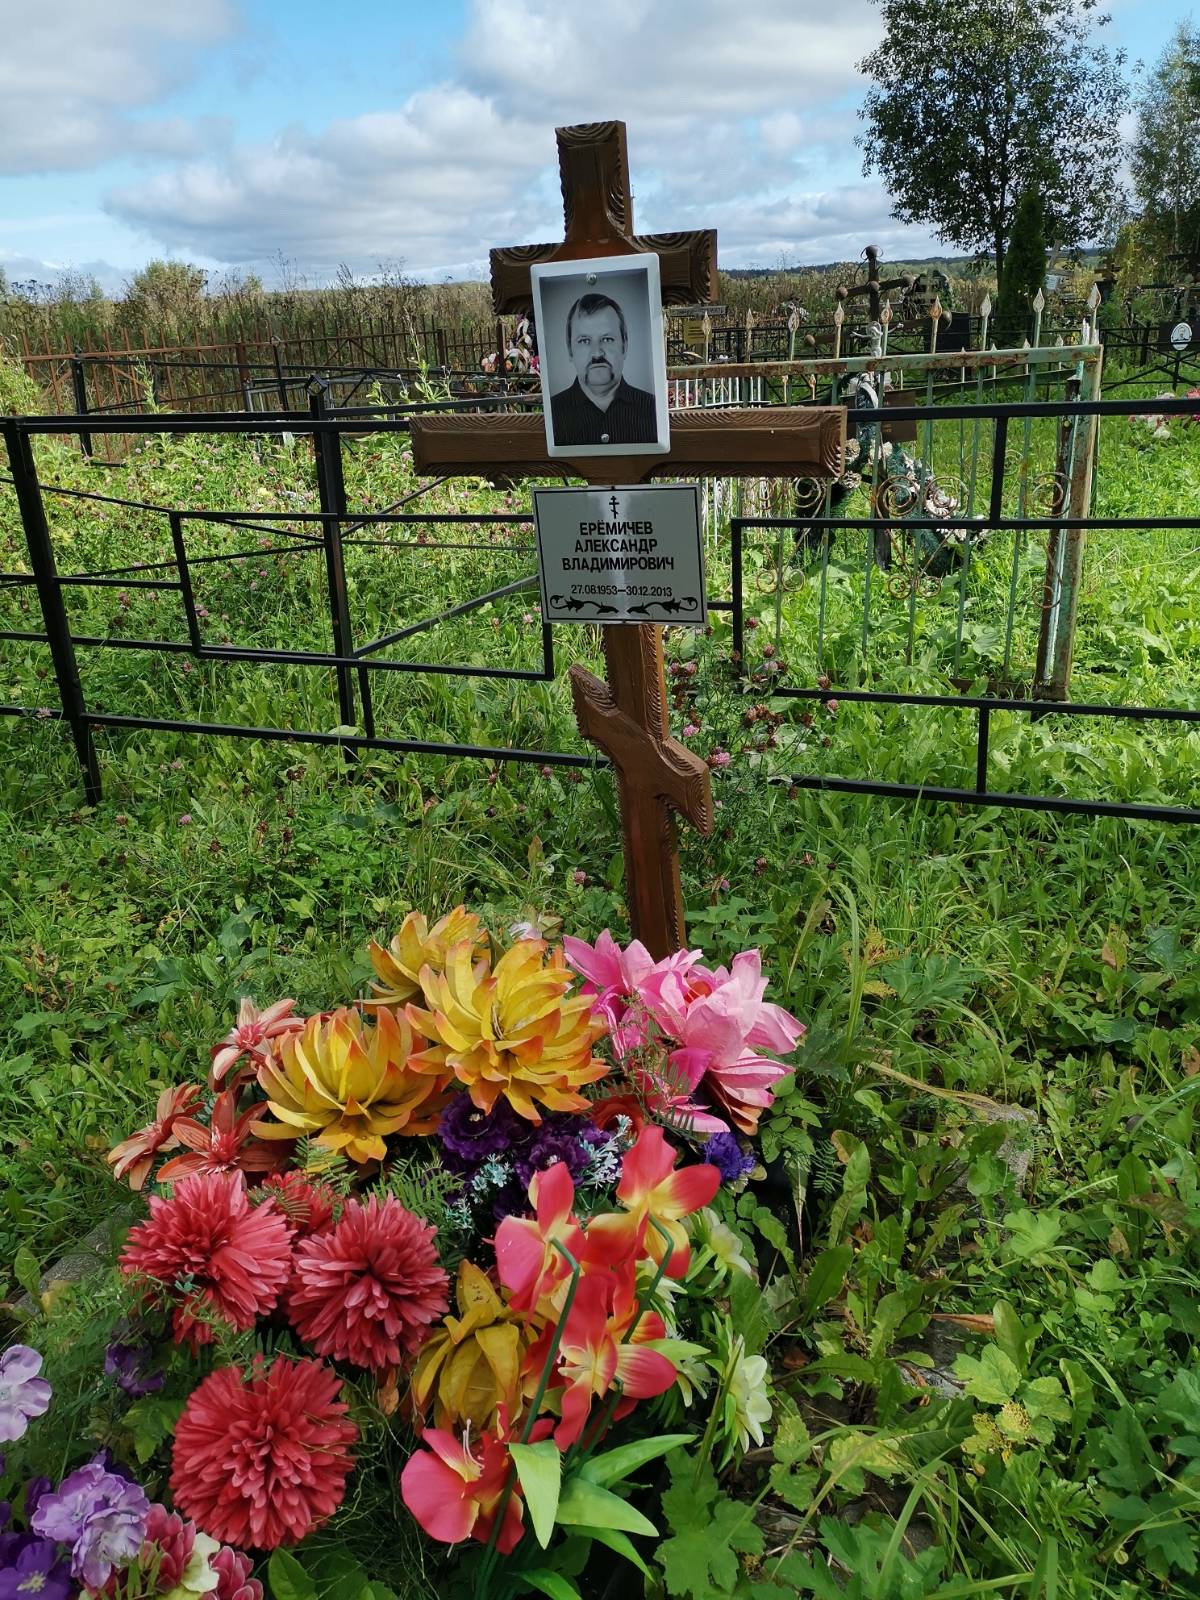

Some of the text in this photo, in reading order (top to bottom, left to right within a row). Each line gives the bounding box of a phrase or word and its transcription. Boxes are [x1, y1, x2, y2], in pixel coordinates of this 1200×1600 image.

[579, 520, 653, 535] ЕРЁМИЧЕВ
[574, 538, 658, 554] АЛЕКСАНДР
[562, 556, 674, 573] ВЛАДИМИРОВИЧ
